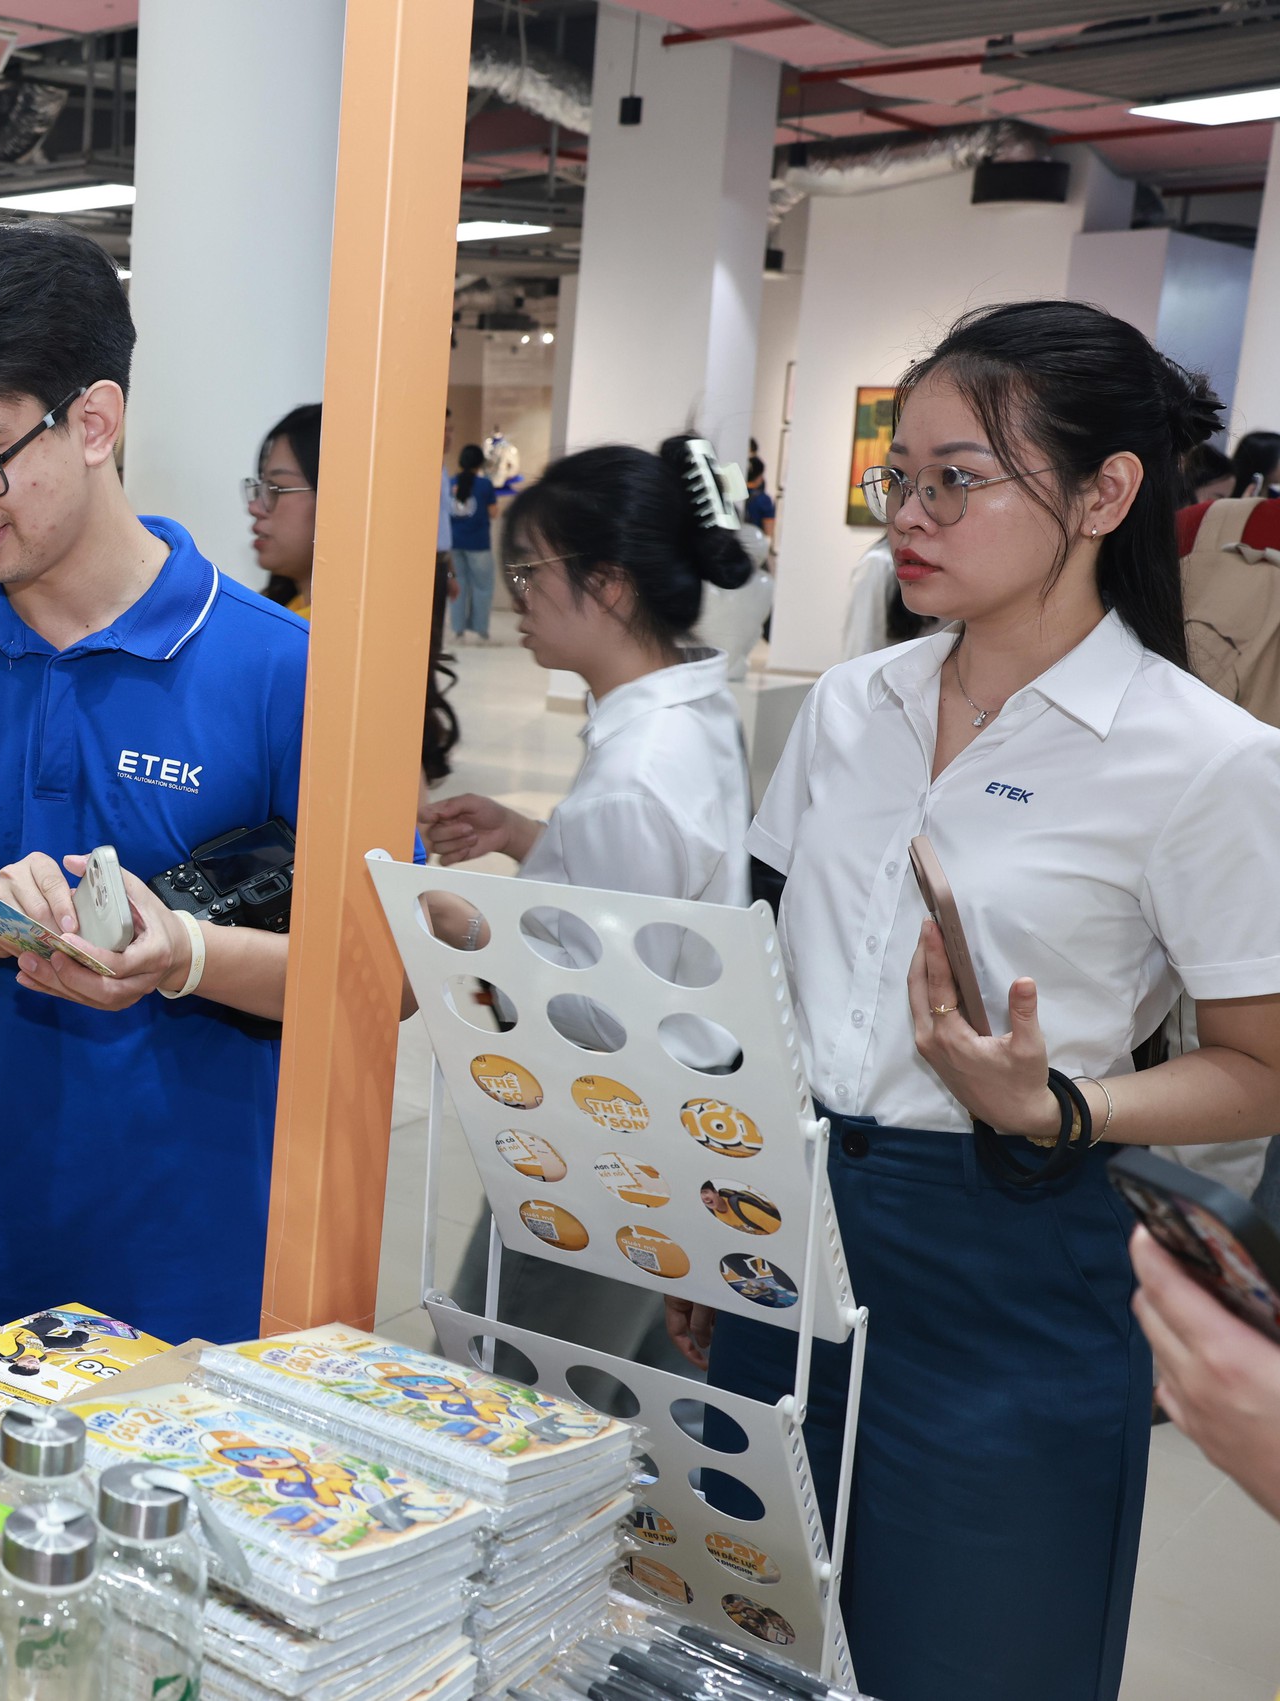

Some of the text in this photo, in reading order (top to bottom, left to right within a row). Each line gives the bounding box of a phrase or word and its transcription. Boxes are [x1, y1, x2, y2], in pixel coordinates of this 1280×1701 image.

[118, 750, 203, 787] ETEK
[116, 771, 199, 794] TOTAL AUTOMATION SOLUTIONS
[985, 782, 1034, 803] ETEK
